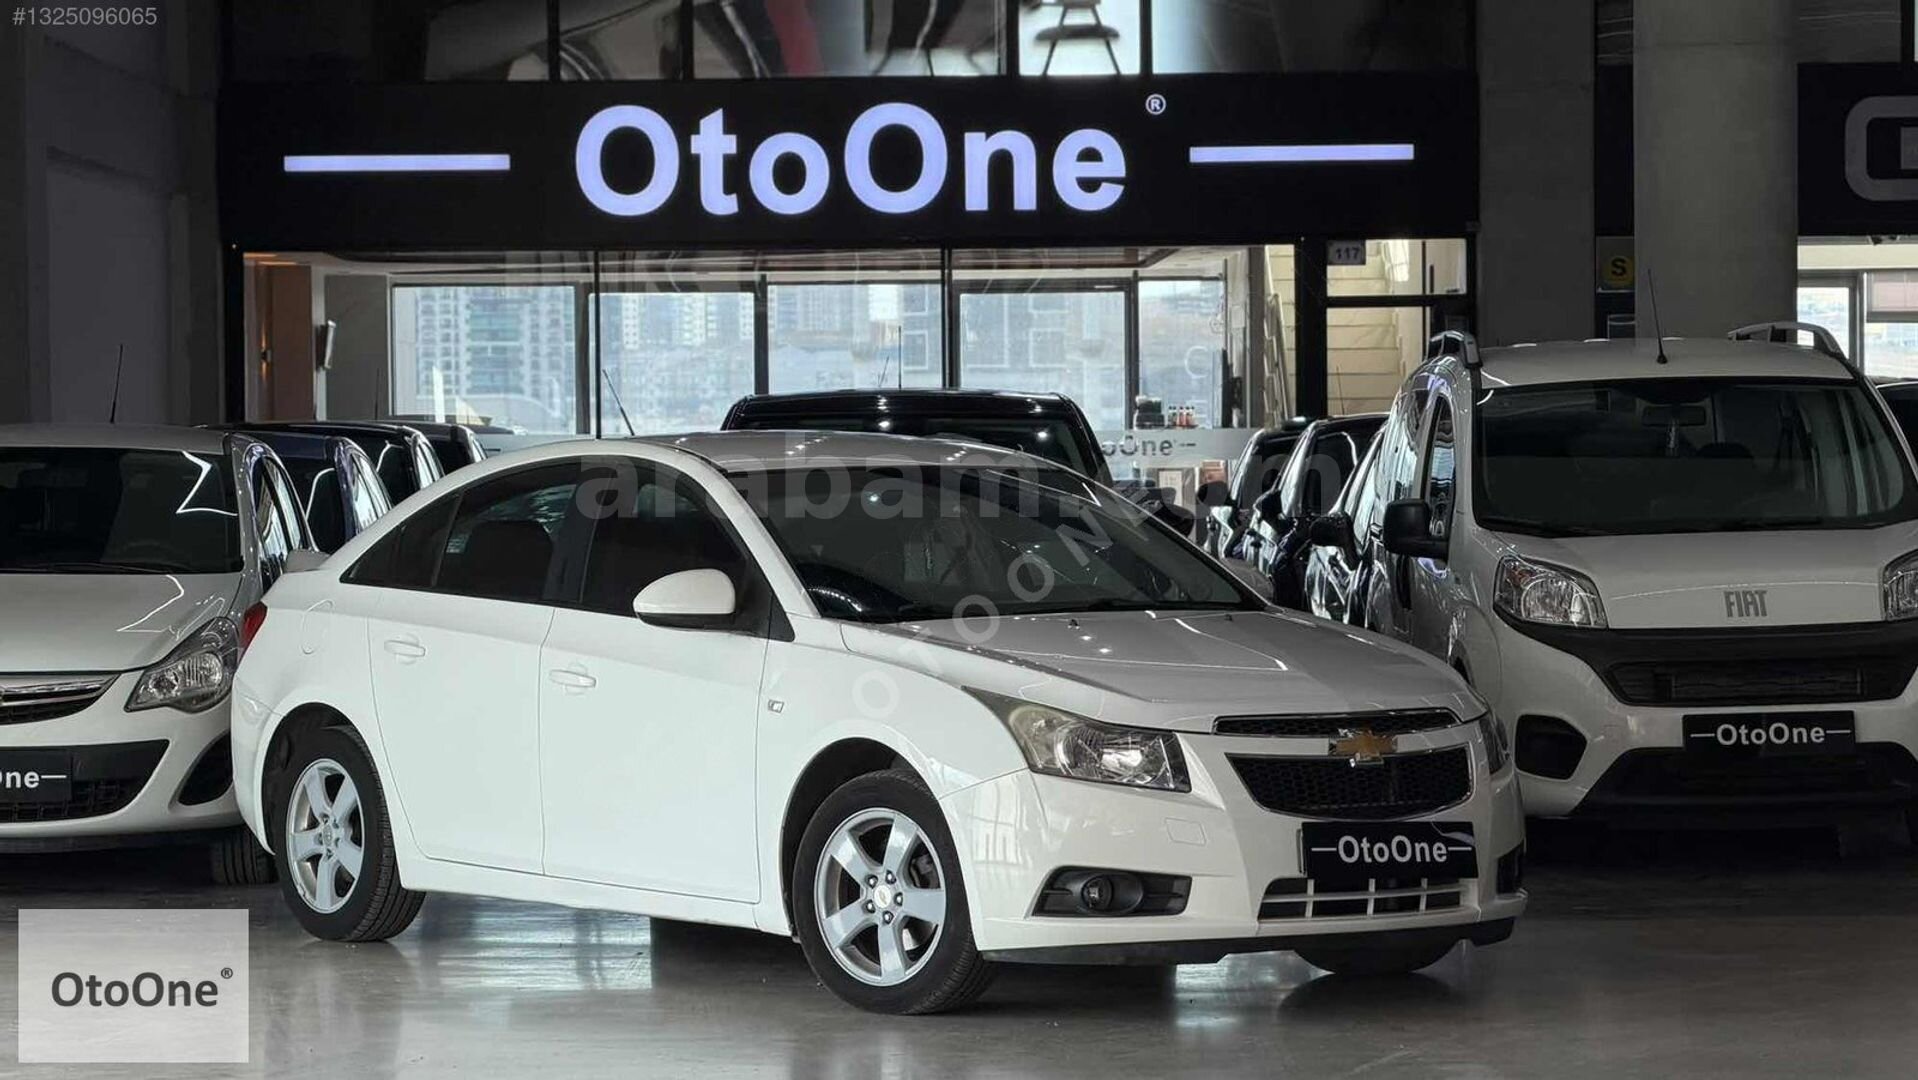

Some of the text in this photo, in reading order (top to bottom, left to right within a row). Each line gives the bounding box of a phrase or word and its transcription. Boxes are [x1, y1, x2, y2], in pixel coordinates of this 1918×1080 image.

[1611, 257, 1627, 277] S
[1723, 589, 1768, 618] FIAT
[1716, 722, 1826, 746] OtoOne
[1337, 834, 1448, 864] OtoOne
